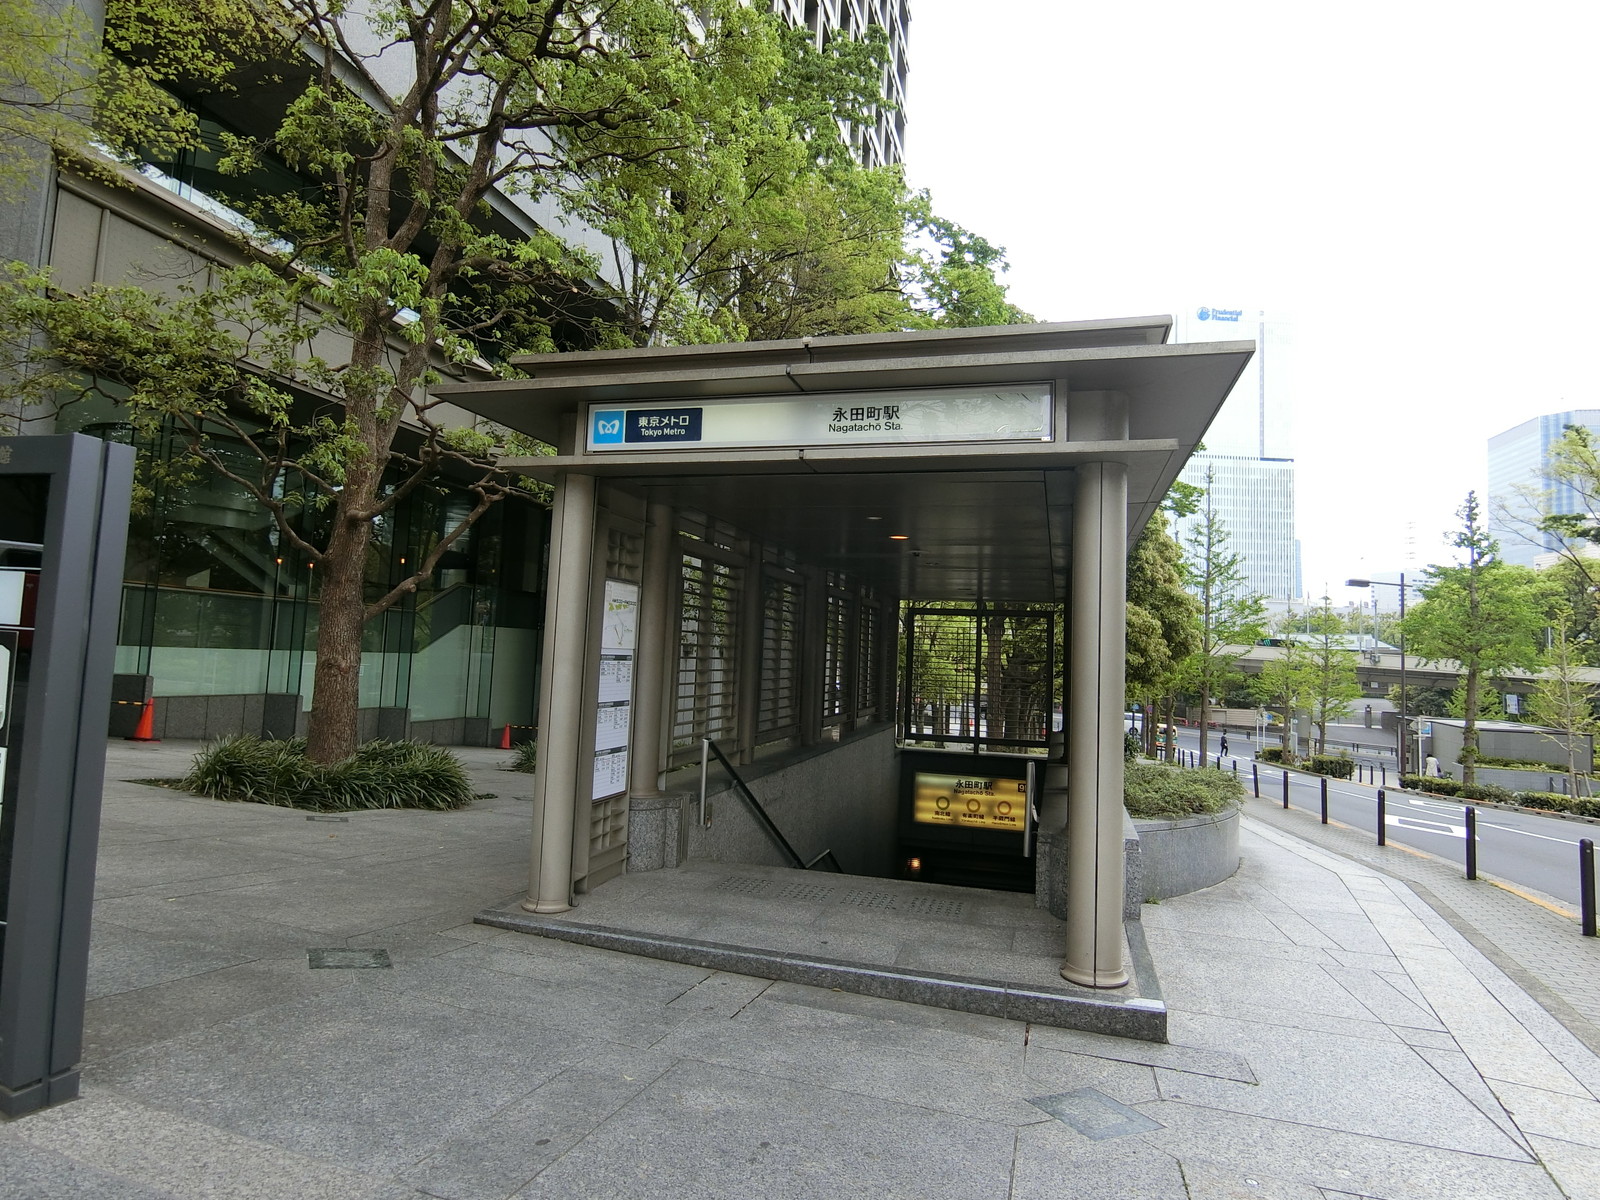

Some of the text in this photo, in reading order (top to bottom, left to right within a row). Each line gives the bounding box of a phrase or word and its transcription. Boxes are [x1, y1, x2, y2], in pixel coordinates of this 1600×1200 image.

[832, 405, 900, 422] 永田町駅
[638, 415, 690, 428] 東京メトロ
[884, 421, 903, 431] Sta.
[640, 427, 686, 437] Tokyo Metro
[955, 780, 993, 790] 永田町駅
